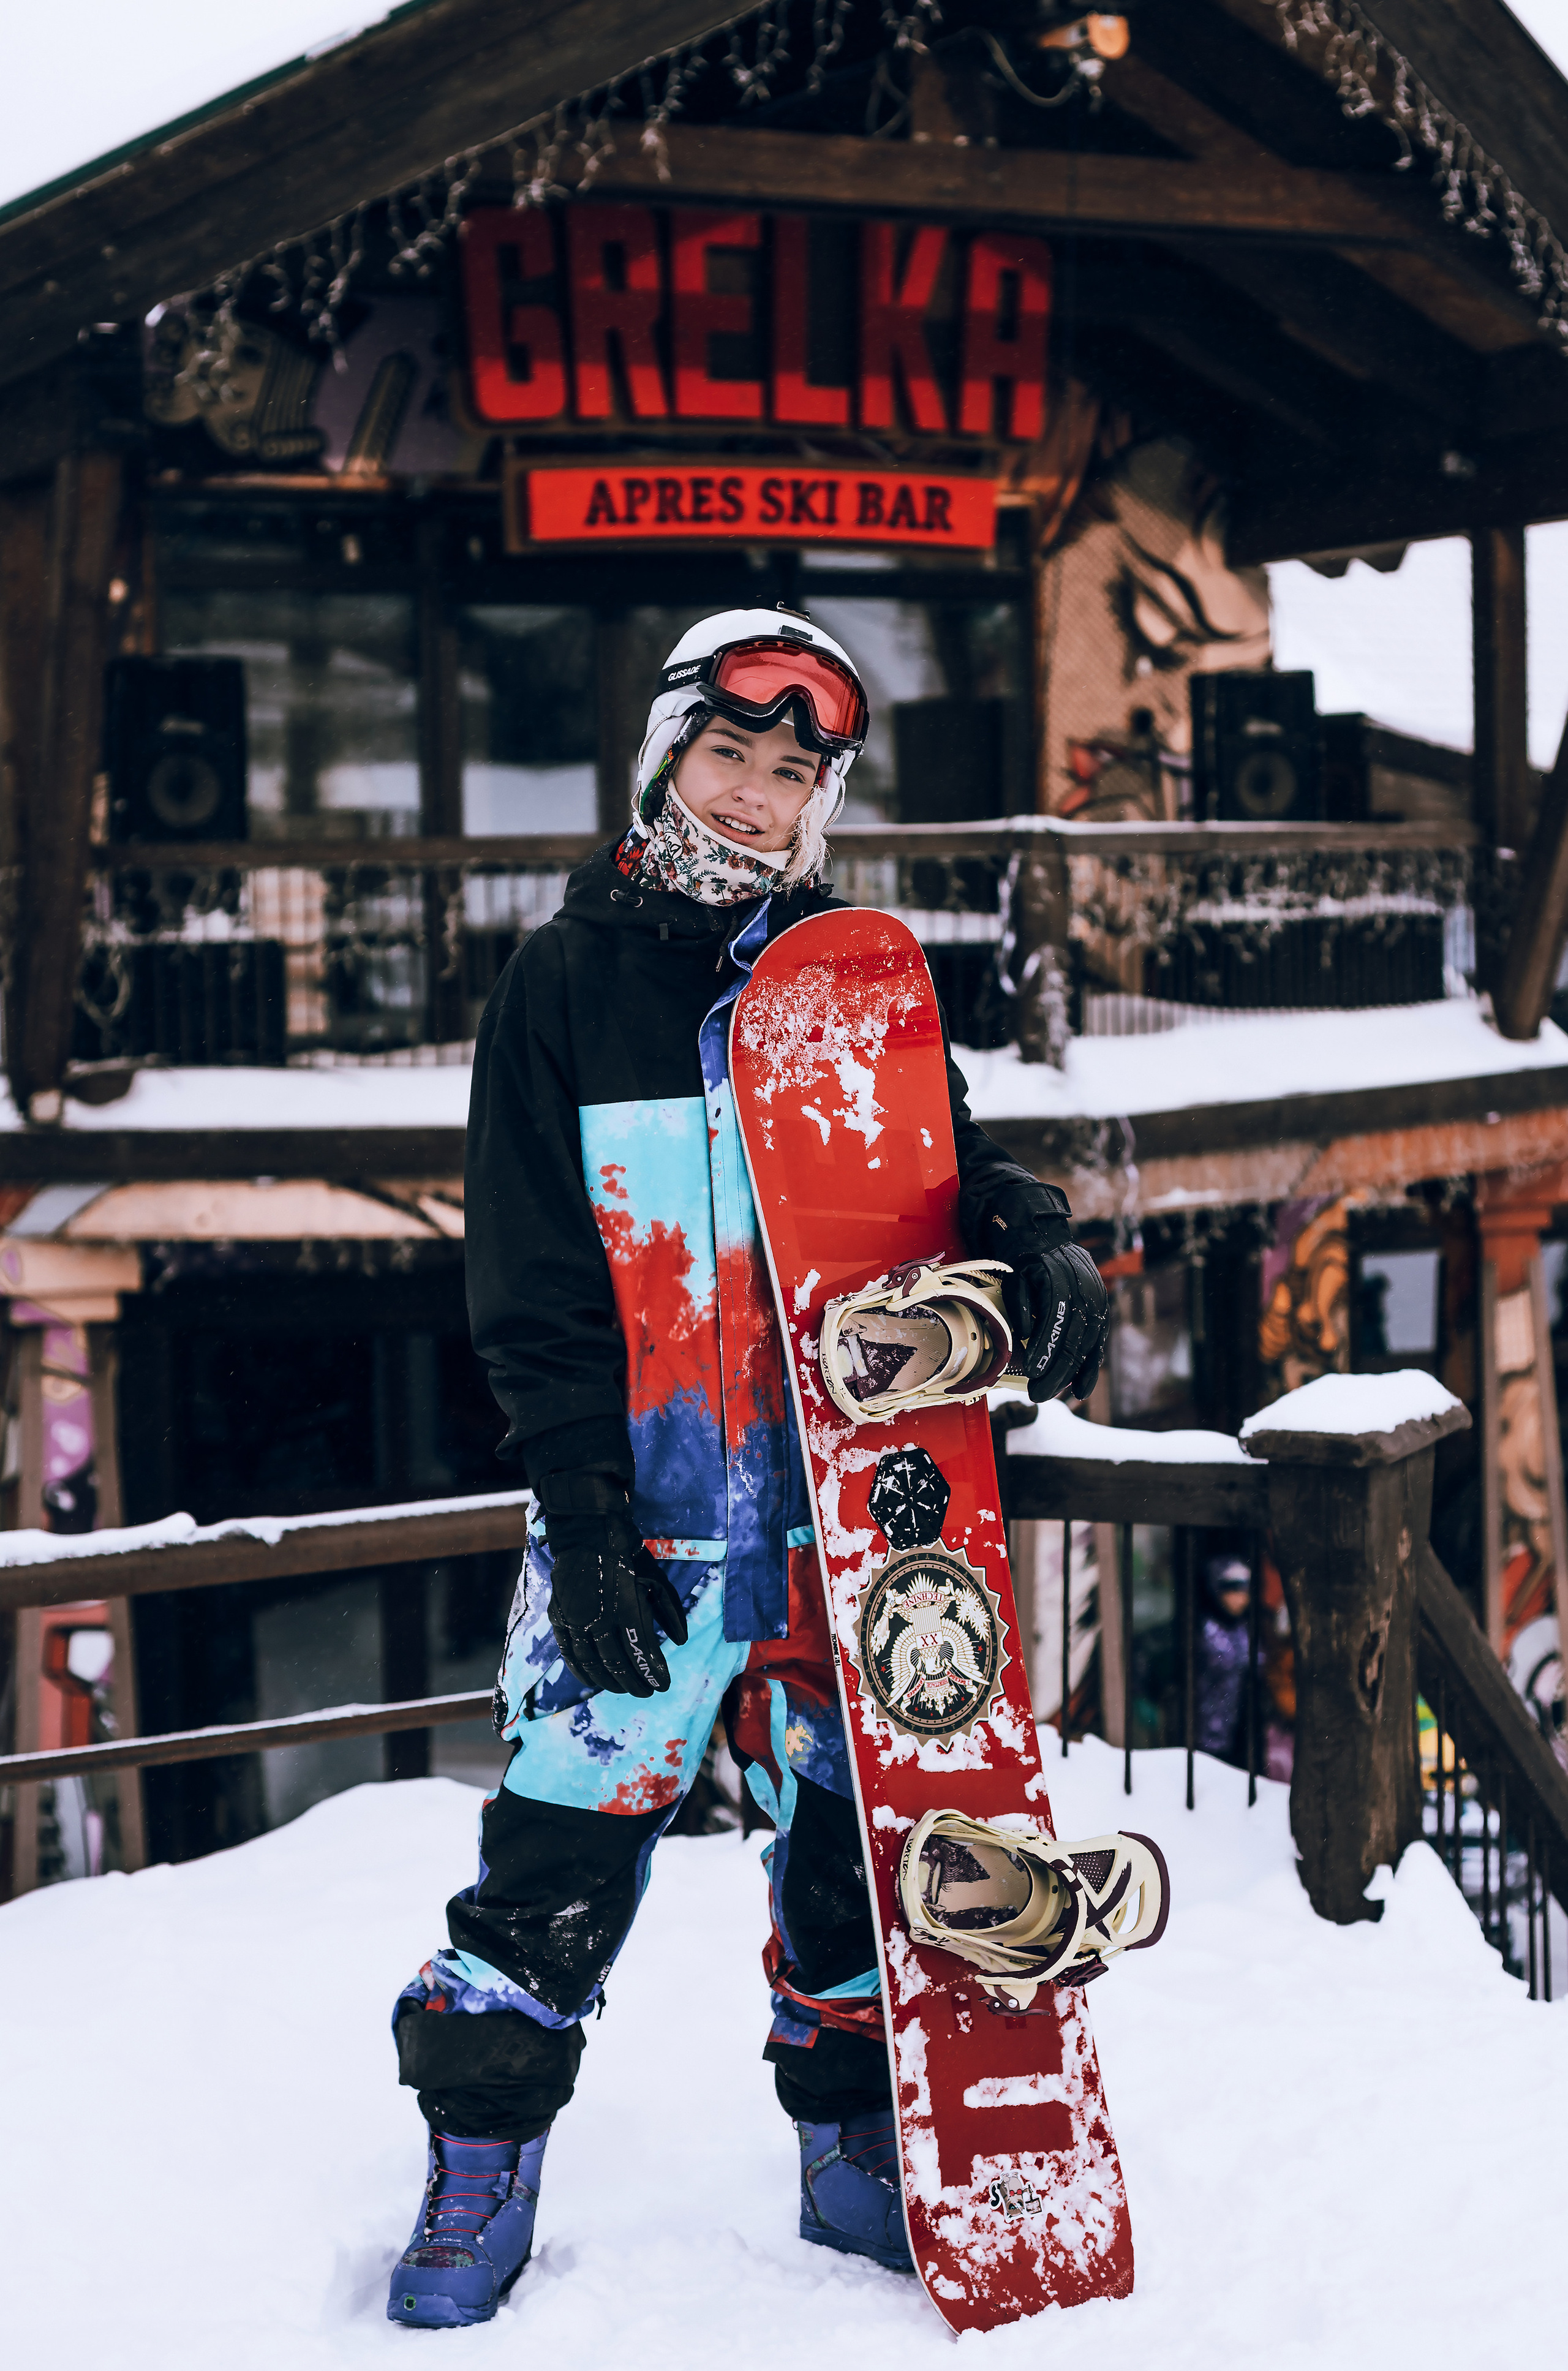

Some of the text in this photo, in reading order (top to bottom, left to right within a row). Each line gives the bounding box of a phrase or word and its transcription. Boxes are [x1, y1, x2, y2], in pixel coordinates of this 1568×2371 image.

[461, 205, 1052, 440] GRELKA
[585, 478, 954, 532] APRES SKI BAR
[668, 665, 701, 681] GLISSADE
[1036, 1300, 1066, 1372] DAKINE
[903, 1593, 943, 1609] TECHNINE
[626, 1627, 660, 1687] DAKINE
